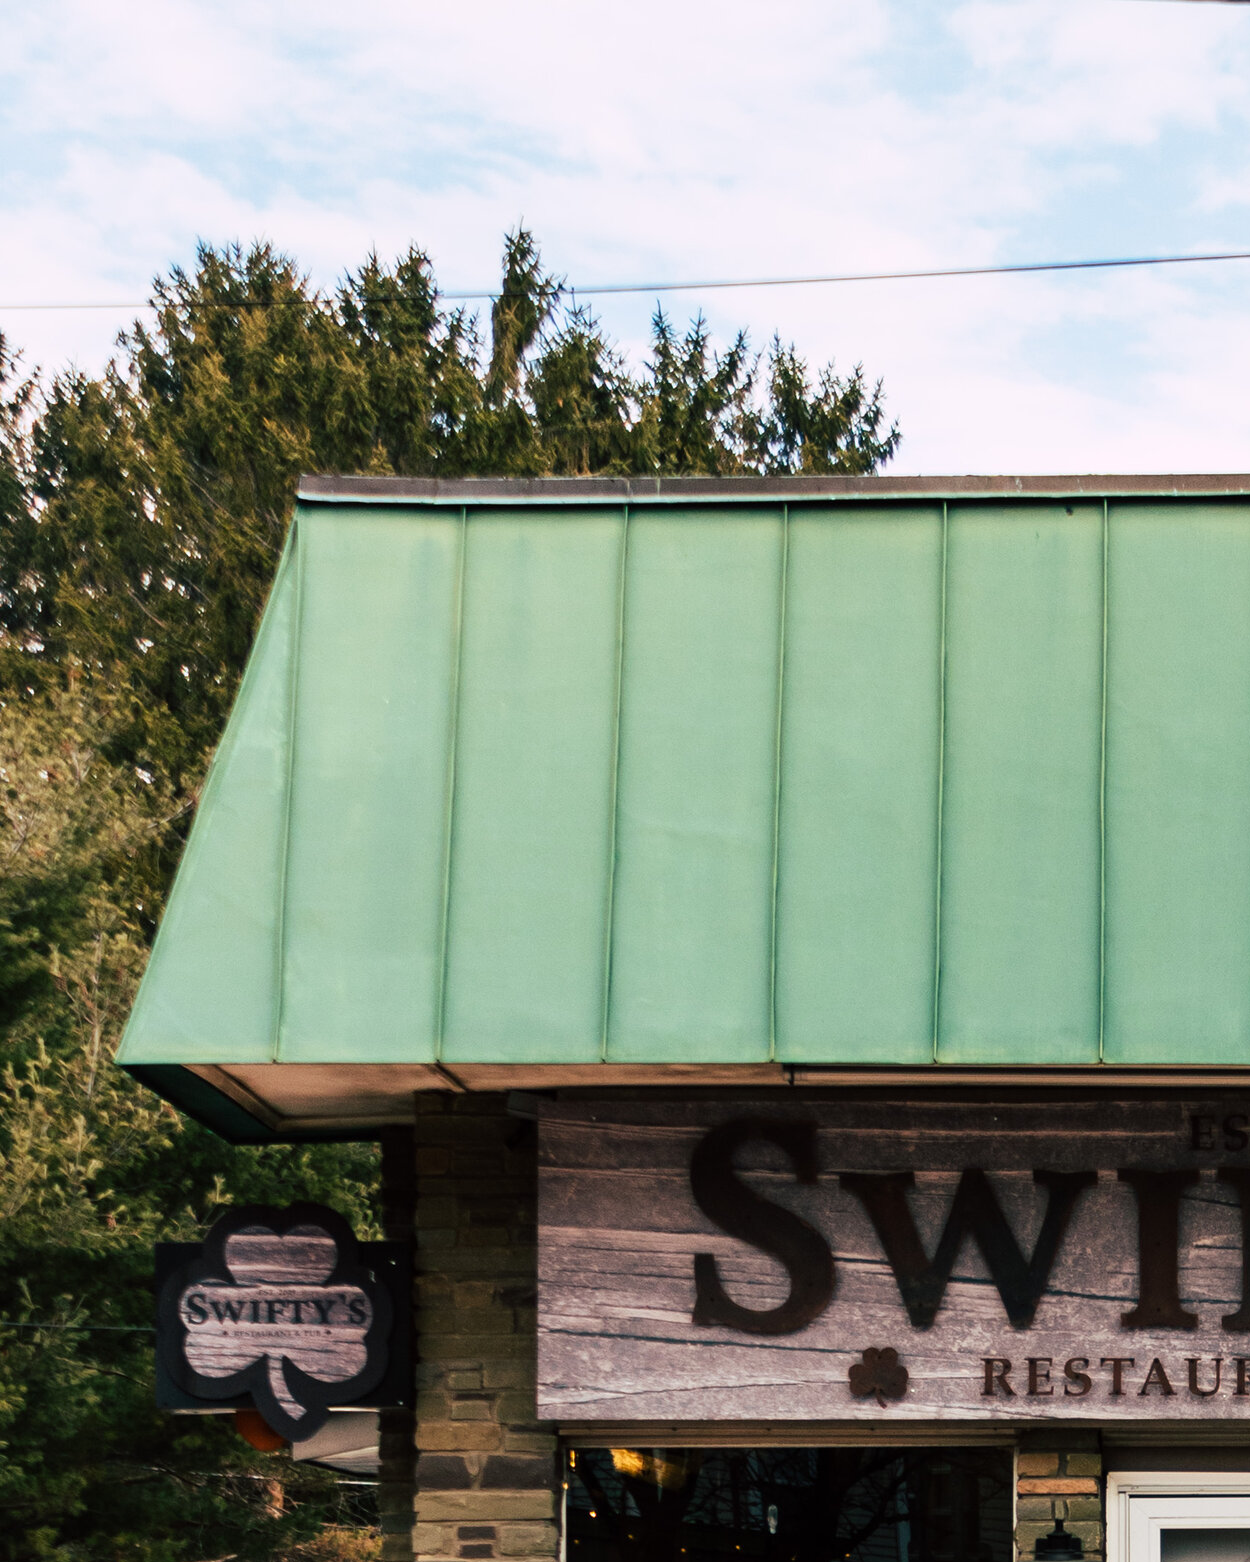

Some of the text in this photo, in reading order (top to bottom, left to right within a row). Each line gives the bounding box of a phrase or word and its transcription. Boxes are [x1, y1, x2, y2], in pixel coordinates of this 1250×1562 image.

[186, 1293, 367, 1325] SWIFTY'S
[233, 1330, 292, 1338] RESTAURANT
[304, 1330, 321, 1338] PUB
